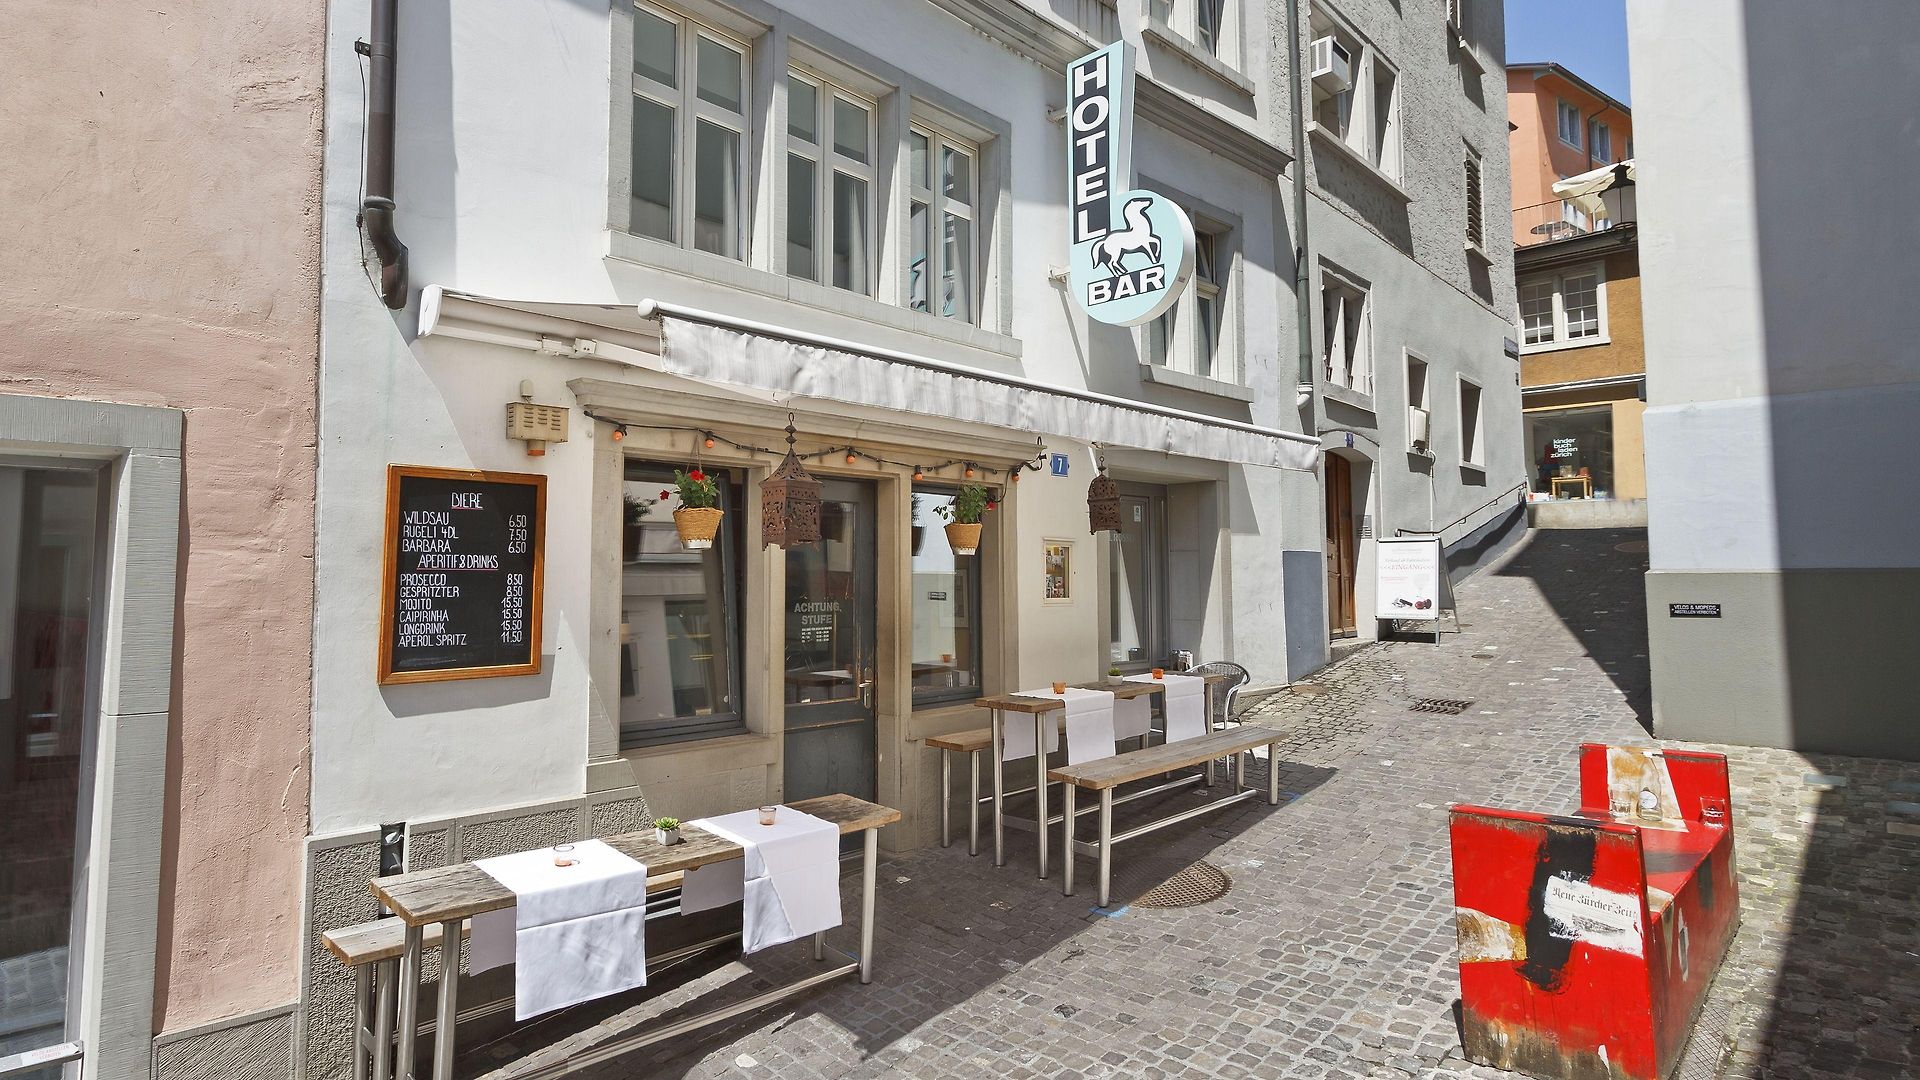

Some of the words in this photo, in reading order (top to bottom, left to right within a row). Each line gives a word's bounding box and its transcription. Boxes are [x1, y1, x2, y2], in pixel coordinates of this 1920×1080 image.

[1072, 56, 1109, 243] HOTEL
[1090, 269, 1164, 305] BAR
[1057, 457, 1063, 473] 7
[451, 493, 483, 509] BIERE
[403, 511, 450, 526] WILDSAU
[508, 515, 527, 528] 6.50
[441, 526, 459, 539] 4DL
[508, 528, 527, 541] 7.50
[402, 539, 451, 553] BARBARA
[508, 542, 527, 554] 6.50
[467, 555, 499, 569] DRINKS
[400, 574, 447, 586] PROSECCO
[506, 574, 523, 585] 8.50
[400, 586, 460, 598] GESPRITZTER
[506, 586, 523, 597] 8.50
[399, 598, 432, 611] MOJITO
[501, 597, 523, 608] 15.50
[399, 610, 449, 622] CAIPIRINHA
[501, 608, 523, 620] 15.50
[801, 614, 833, 625] STUFE
[398, 622, 446, 635] LONGDRINK
[501, 620, 523, 631] 15.50
[398, 635, 434, 648] APEROL
[435, 633, 467, 646] SPRITZ
[501, 631, 523, 643] 11.50
